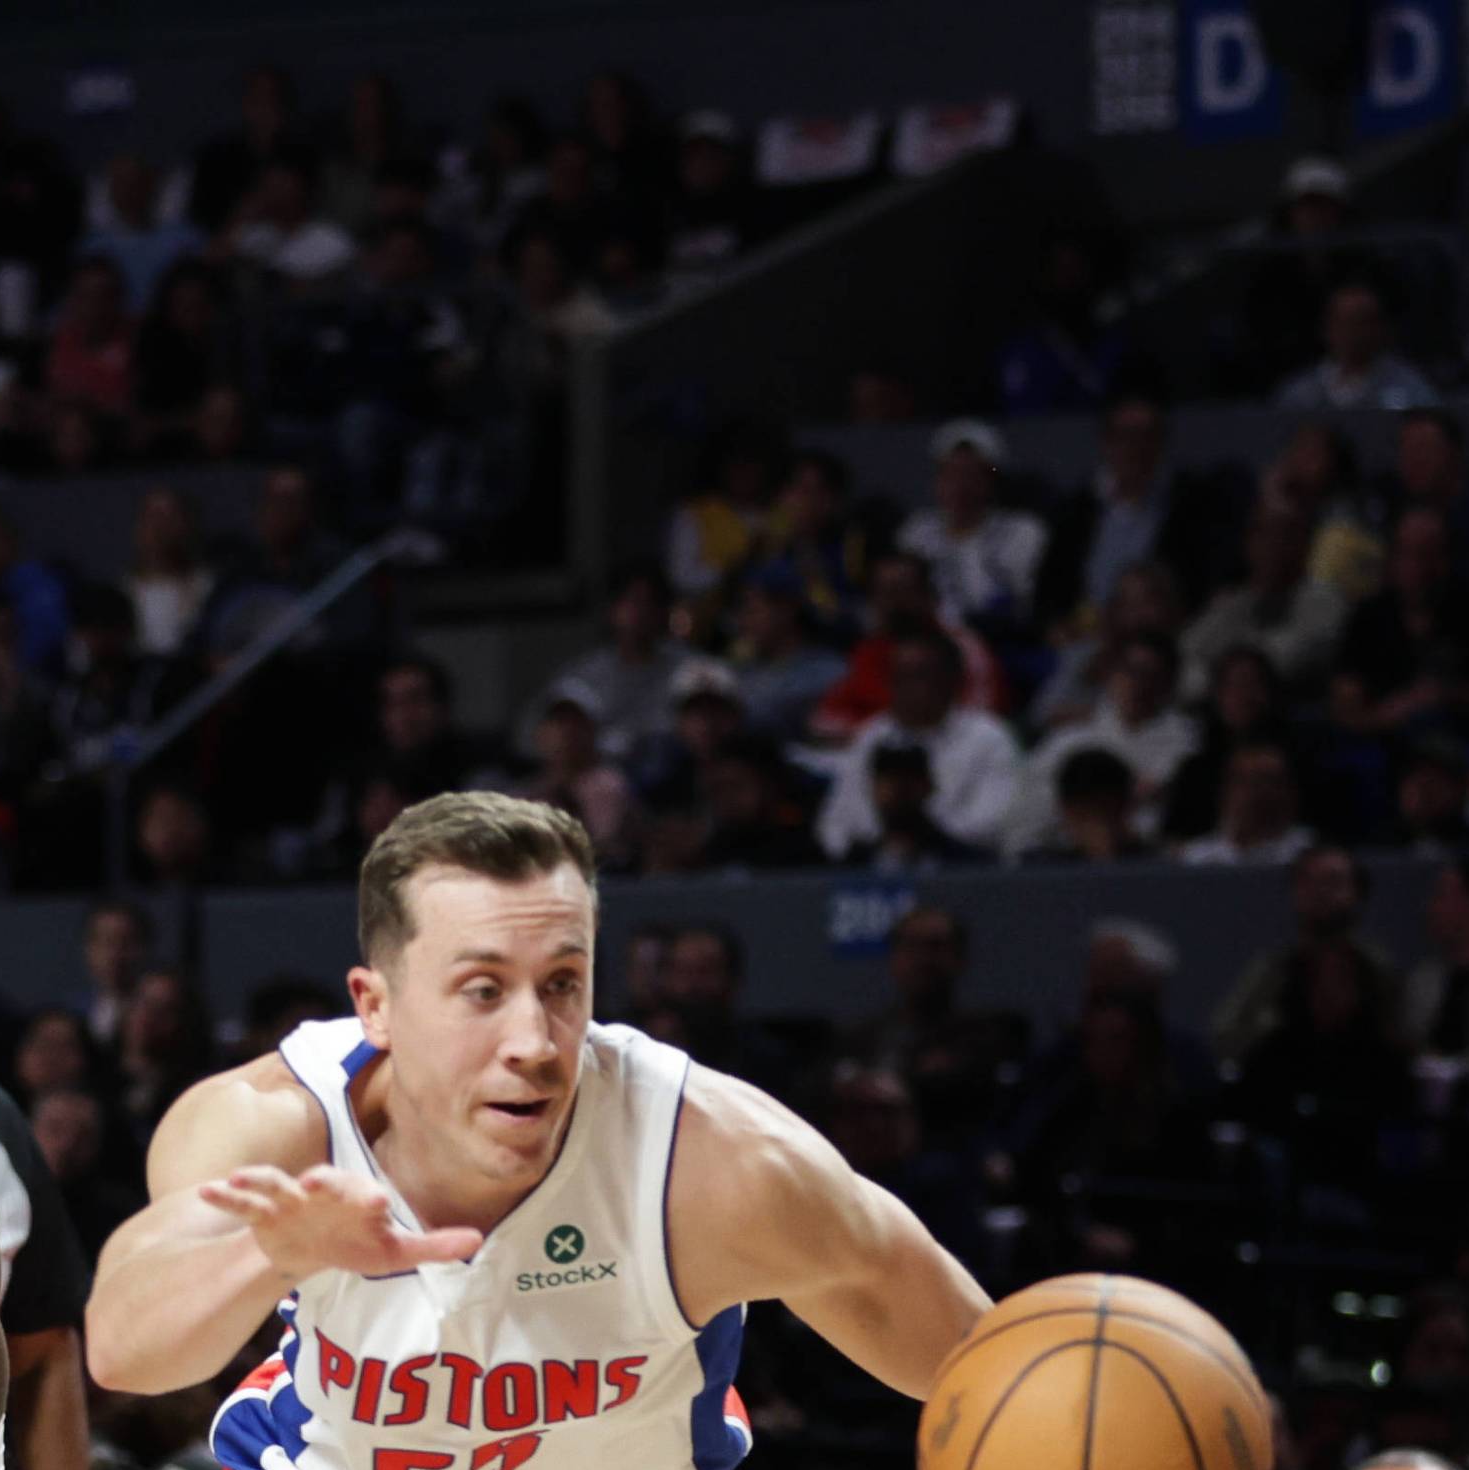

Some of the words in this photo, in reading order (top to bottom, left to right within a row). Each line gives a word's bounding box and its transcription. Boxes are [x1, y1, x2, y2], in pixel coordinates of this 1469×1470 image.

[1193, 10, 1269, 115] D
[1367, 5, 1442, 108] D
[516, 1261, 618, 1292] StockX
[313, 1325, 649, 1432] PISTONS
